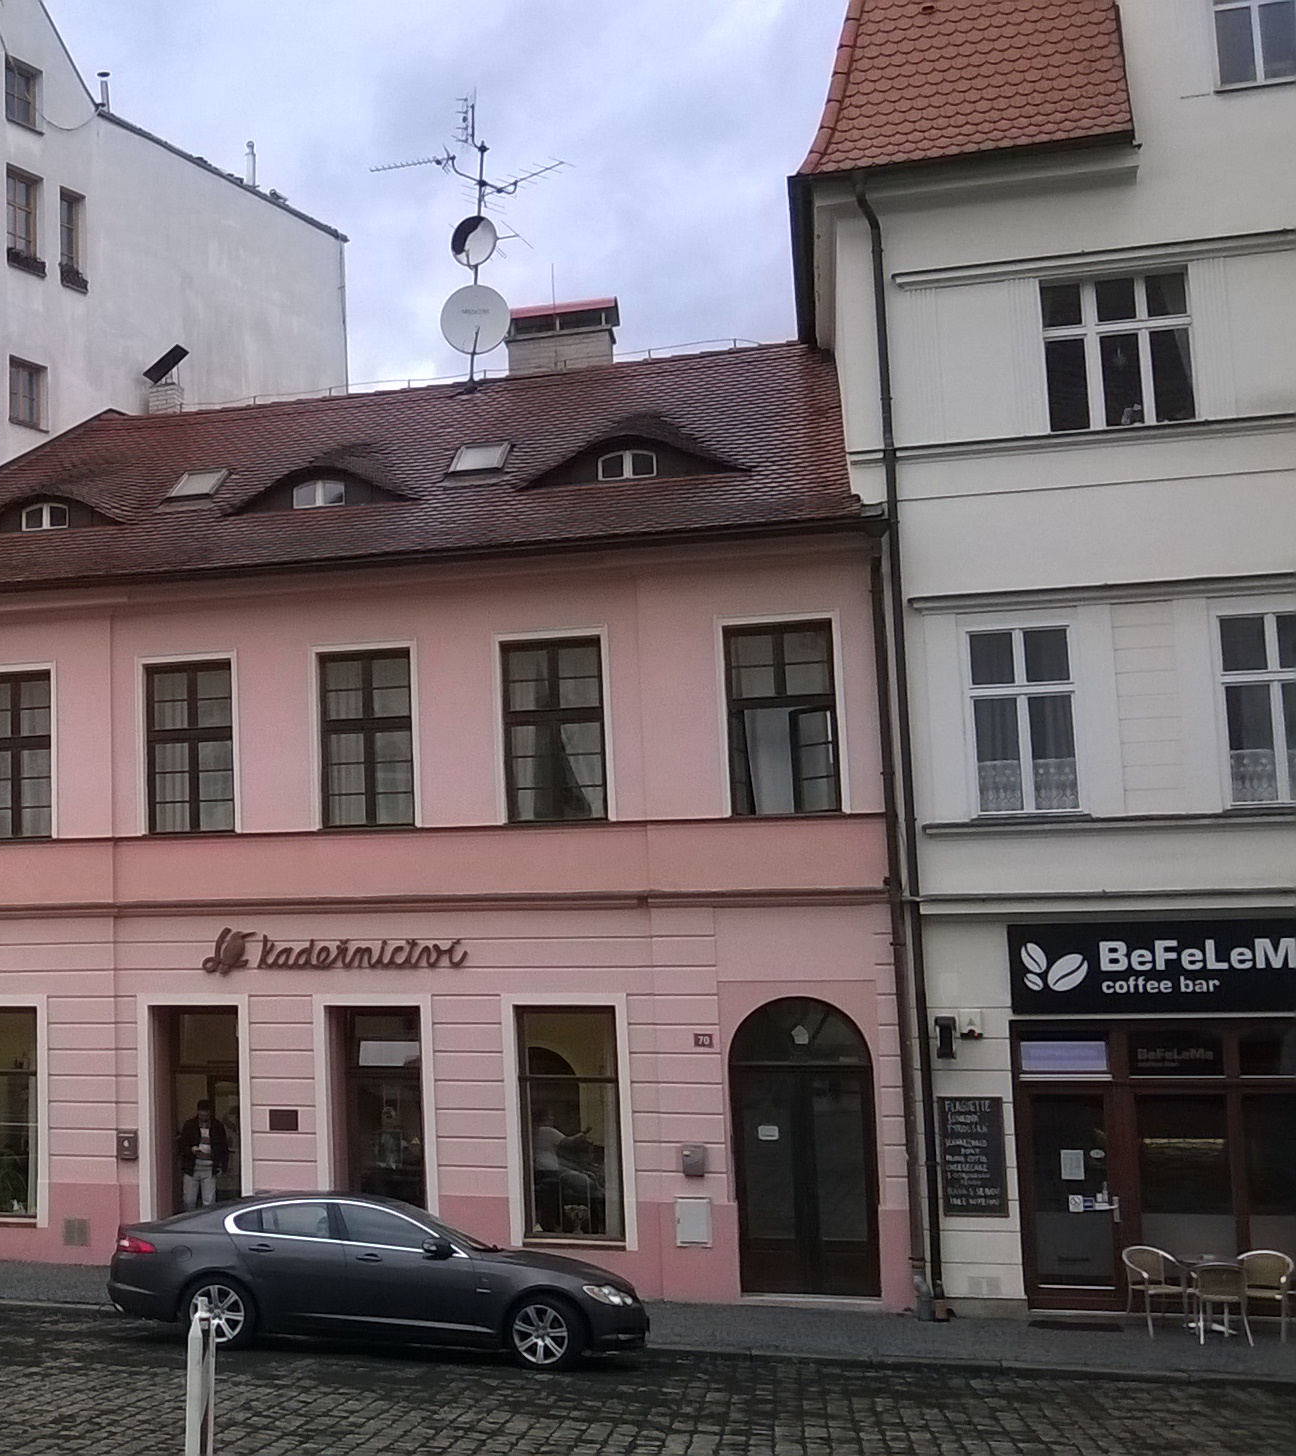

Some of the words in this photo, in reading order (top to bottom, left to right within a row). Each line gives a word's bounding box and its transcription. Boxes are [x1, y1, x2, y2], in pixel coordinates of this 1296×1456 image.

[1099, 938, 1296, 971] BeFeLeM
[1102, 976, 1173, 993] coffee
[1180, 975, 1220, 993] bar
[698, 1036, 710, 1045] 70
